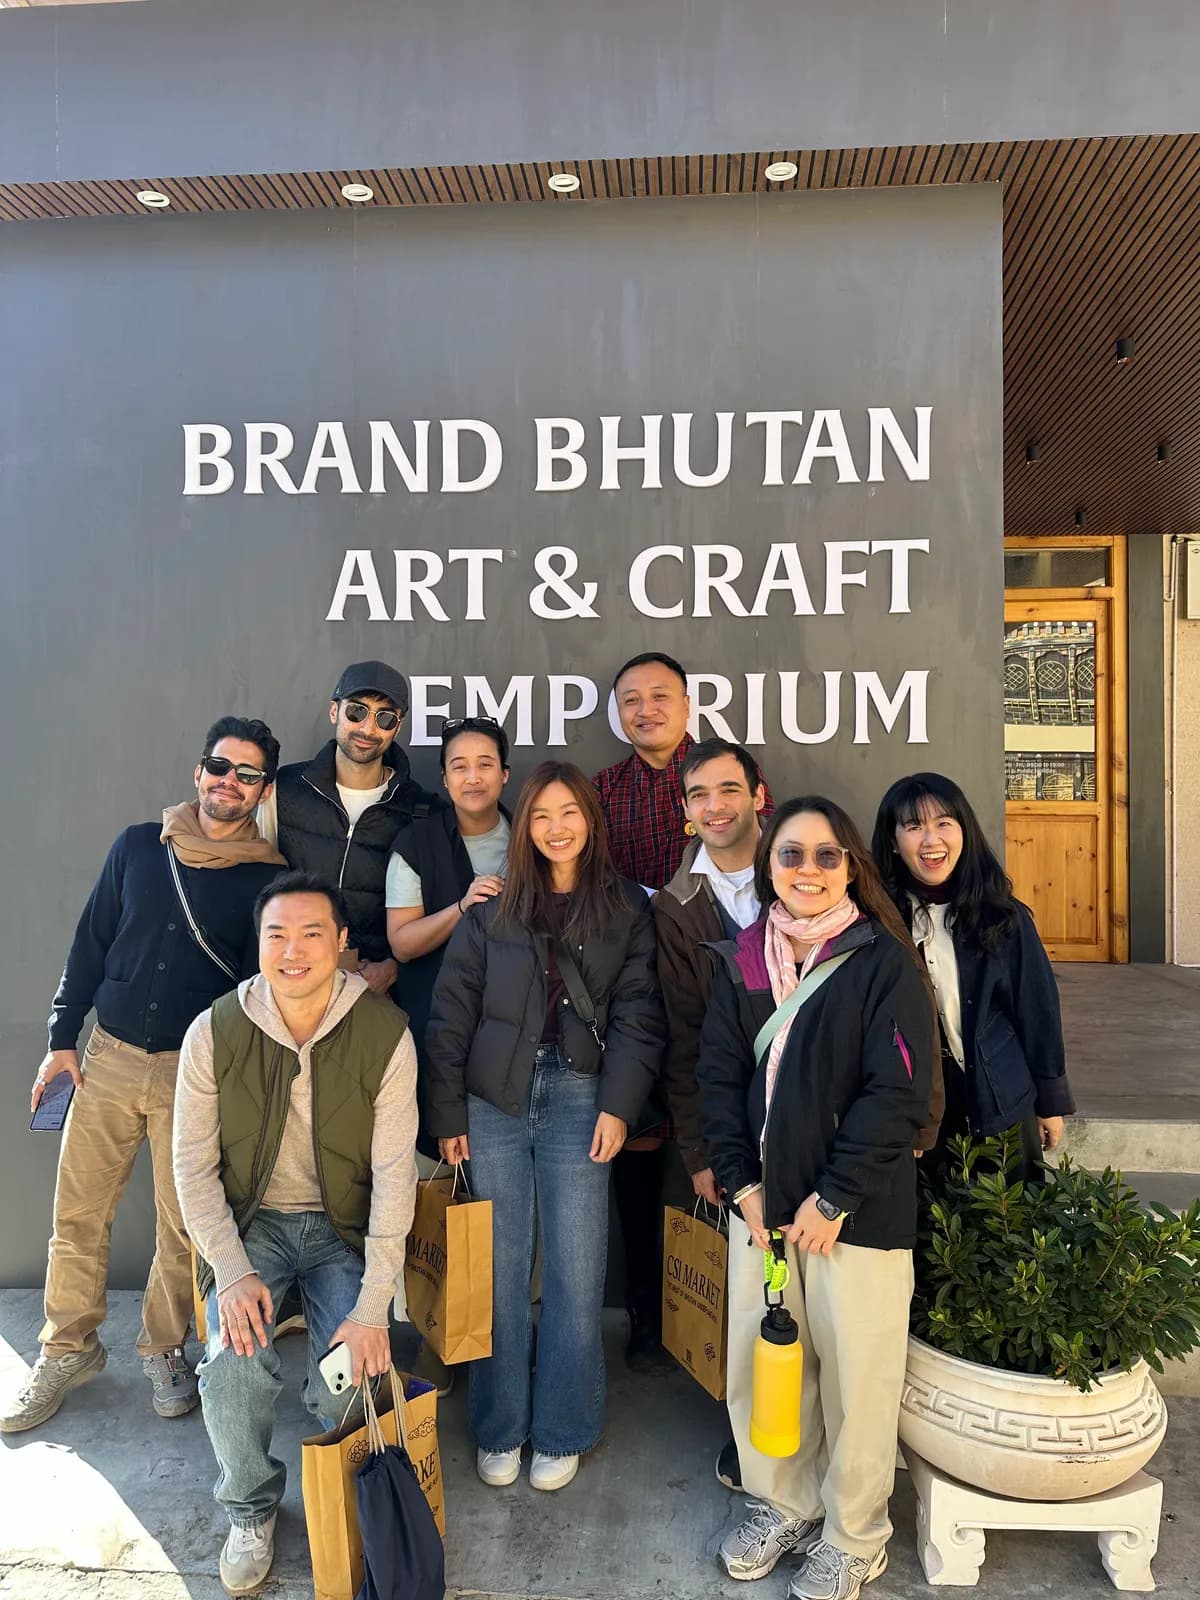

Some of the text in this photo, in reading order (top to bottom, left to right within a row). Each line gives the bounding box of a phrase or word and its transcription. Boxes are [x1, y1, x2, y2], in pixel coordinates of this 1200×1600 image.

[183, 407, 933, 494] BRAND BHUTAN
[326, 539, 929, 621] ART & CRAFT
[408, 670, 930, 747] EMPRIUM
[667, 1255, 682, 1281] CSI
[682, 1263, 721, 1310] MARKET
